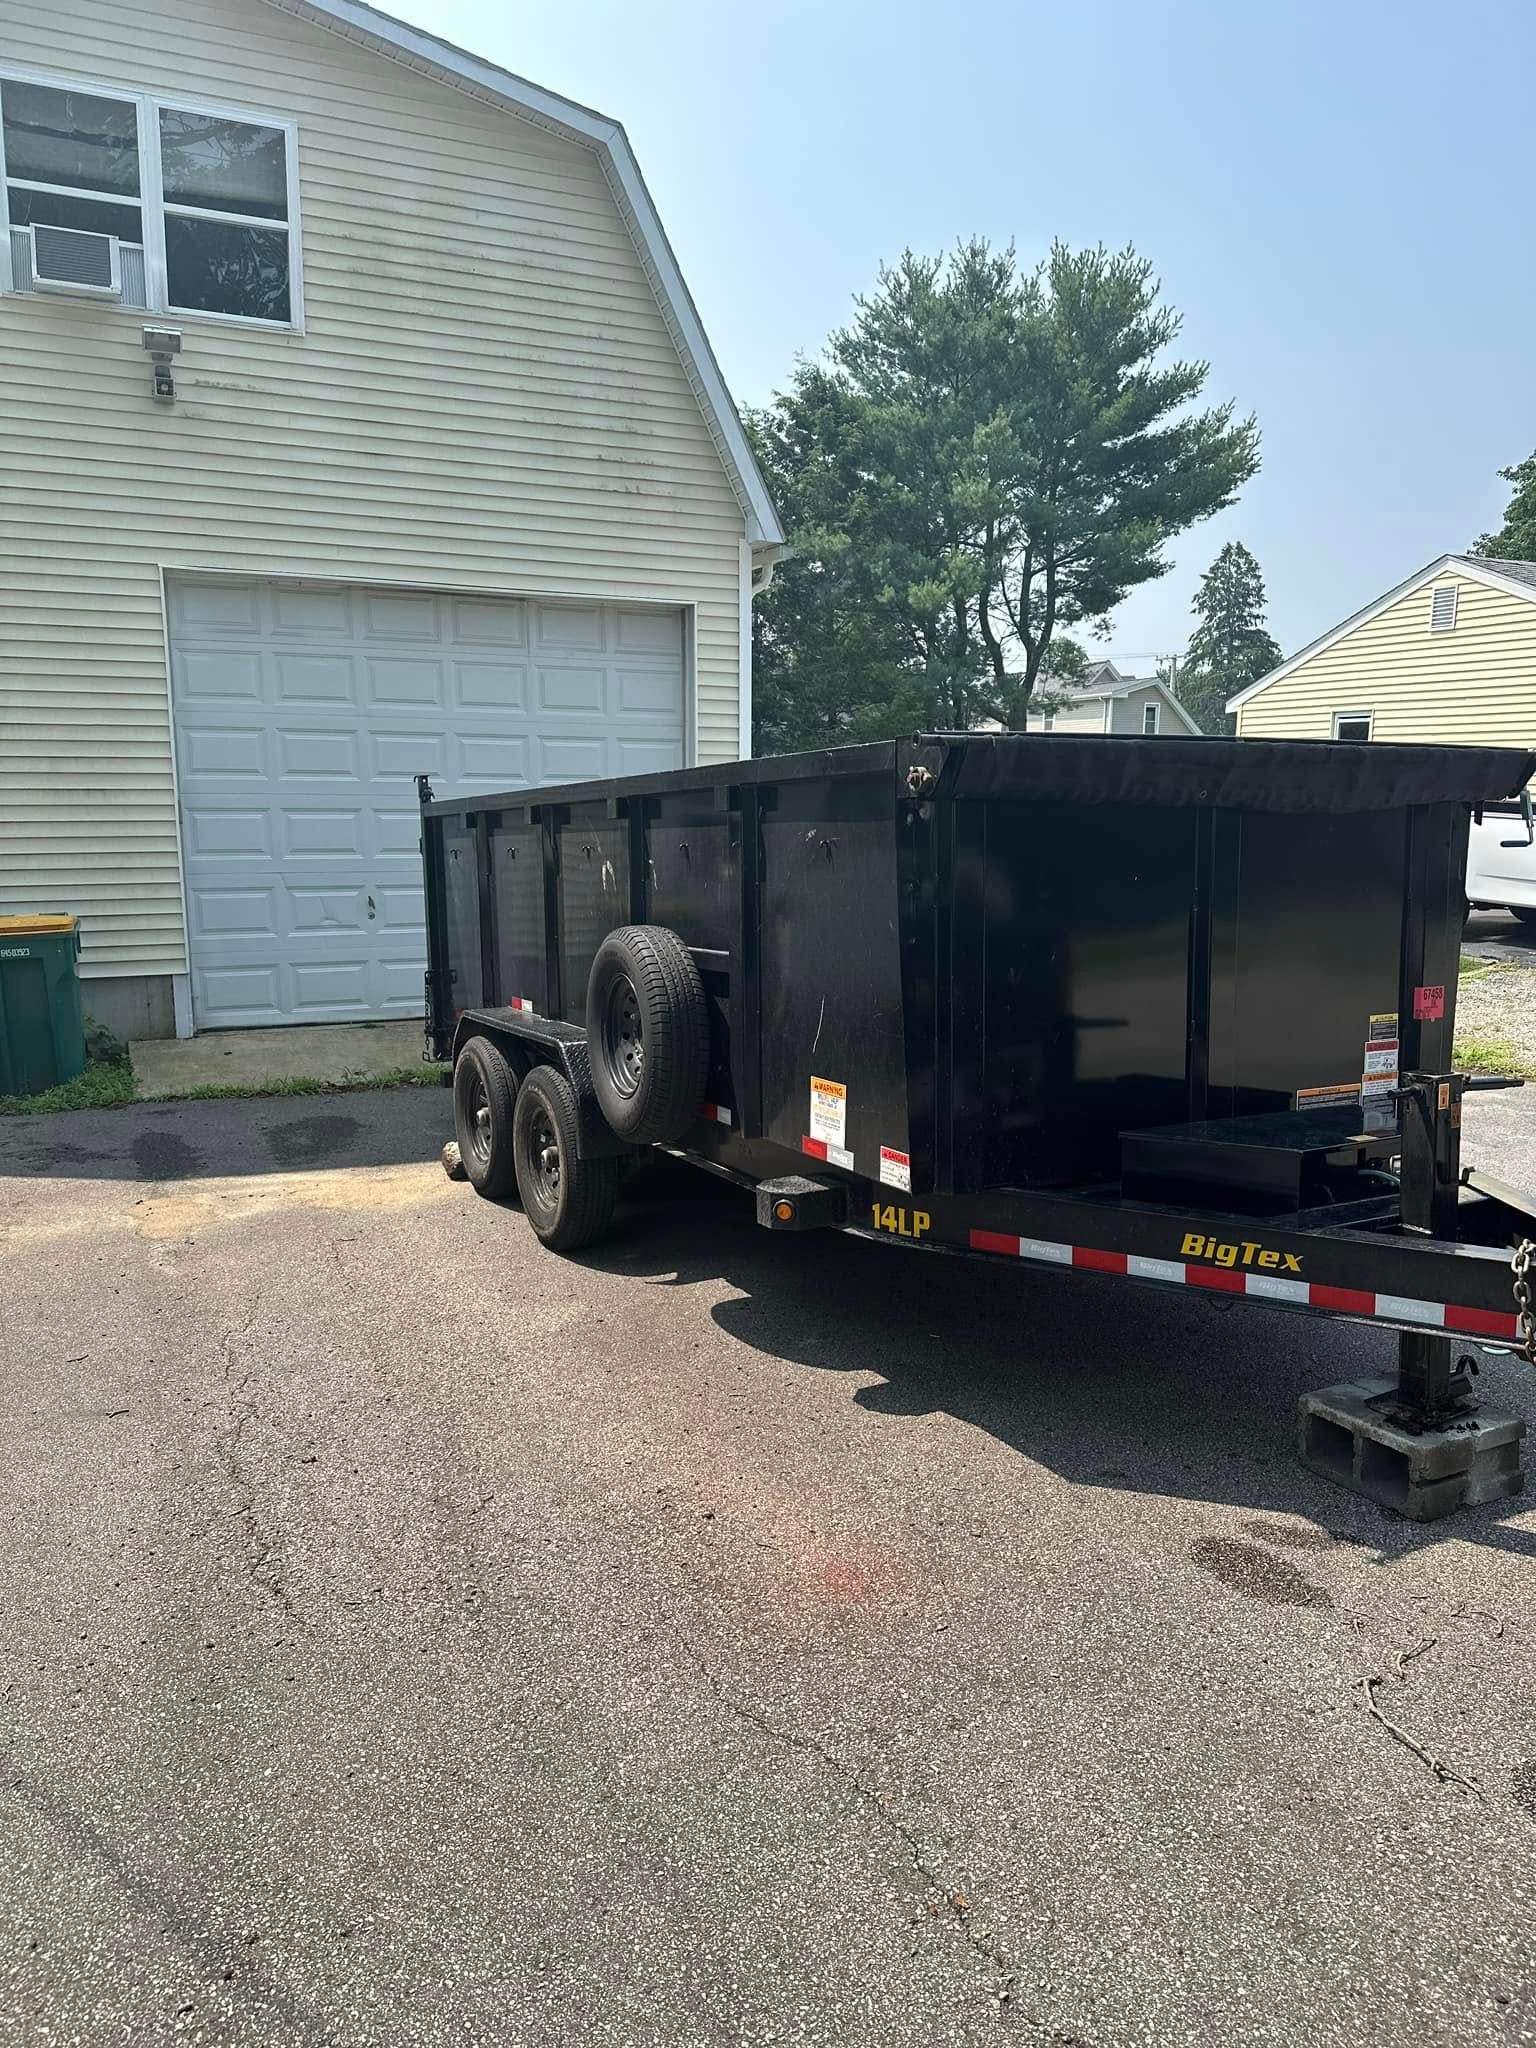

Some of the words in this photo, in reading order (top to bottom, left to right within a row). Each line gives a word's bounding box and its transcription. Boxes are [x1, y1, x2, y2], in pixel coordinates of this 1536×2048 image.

[1423, 987, 1443, 1000] 67458
[819, 1082, 843, 1097] WARNING
[887, 1150, 907, 1165] DANGER
[872, 1203, 930, 1238] 14LP
[1180, 1233, 1304, 1272] BigTex
